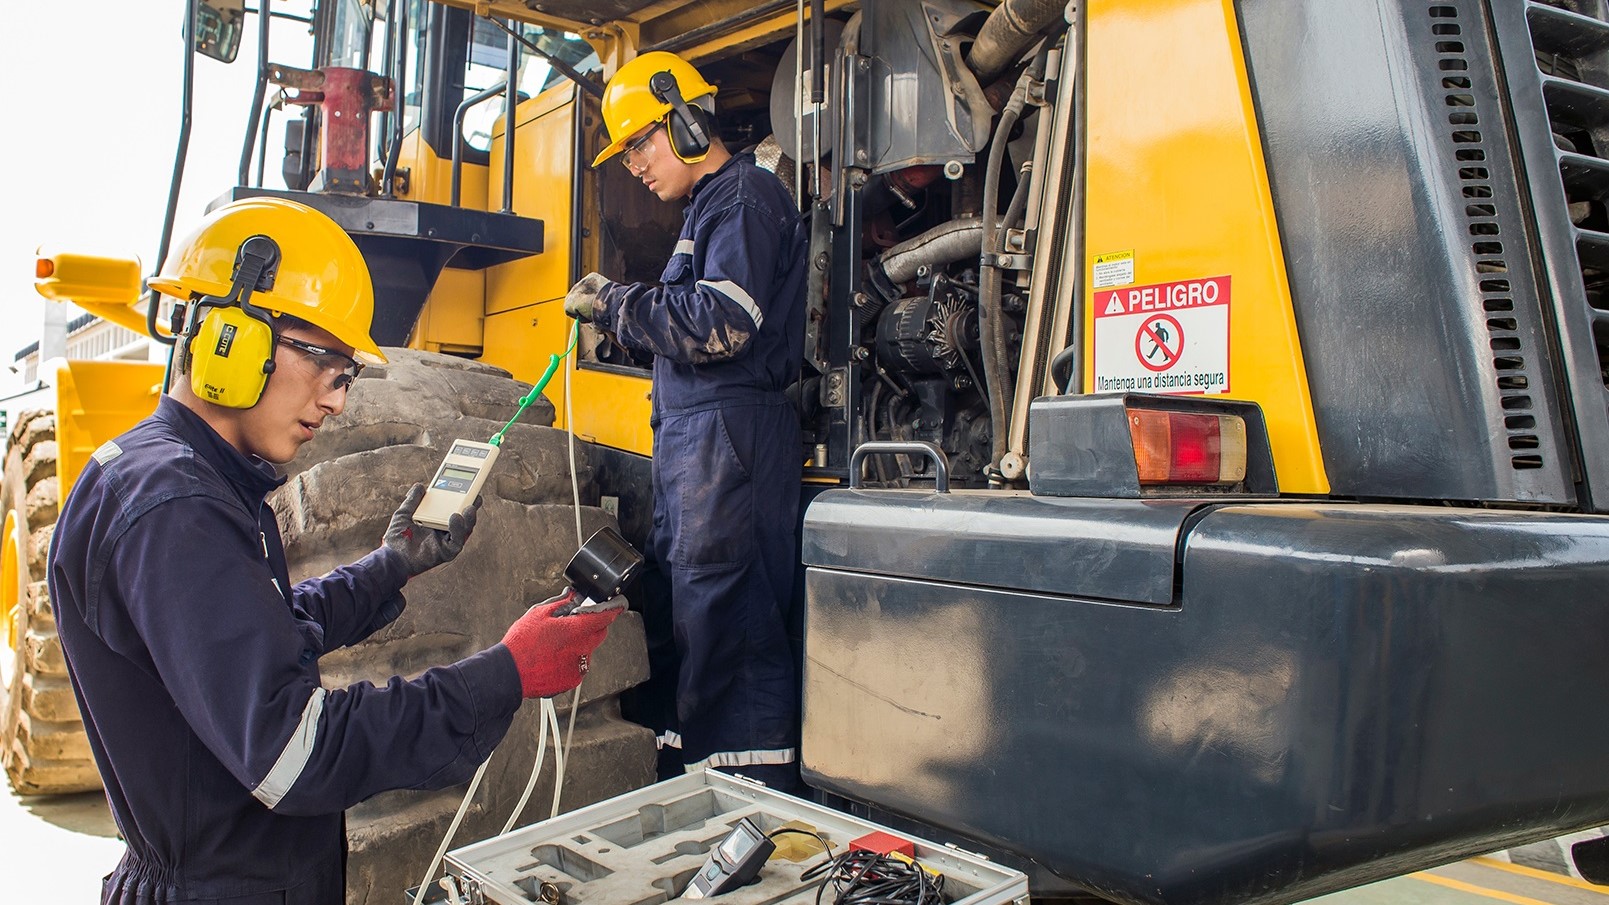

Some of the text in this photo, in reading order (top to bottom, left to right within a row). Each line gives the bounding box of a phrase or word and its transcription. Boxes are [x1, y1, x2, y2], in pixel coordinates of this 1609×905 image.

[1128, 280, 1219, 312] PELIGRO
[1098, 371, 1224, 392] Mantenga una distancia segura
